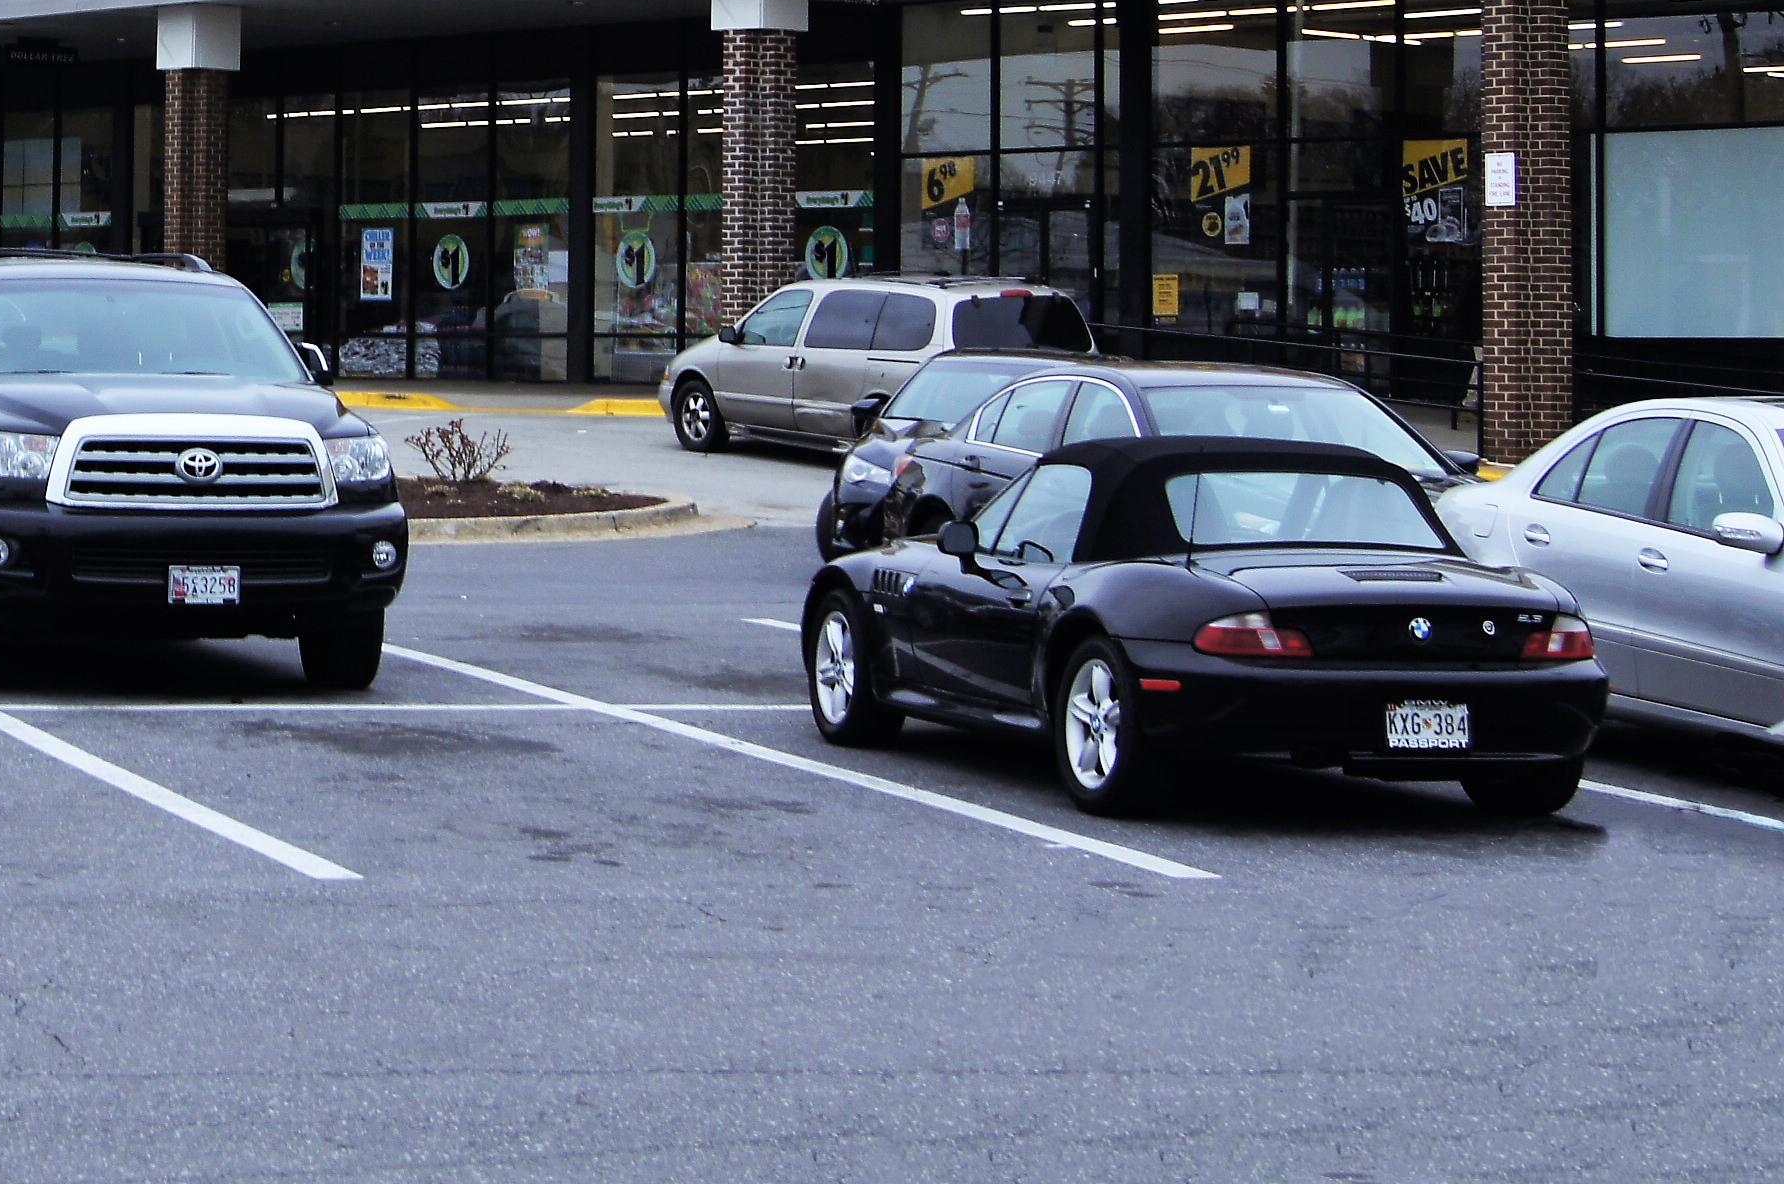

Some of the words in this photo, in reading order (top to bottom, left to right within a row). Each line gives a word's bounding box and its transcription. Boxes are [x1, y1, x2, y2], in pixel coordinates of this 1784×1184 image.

[1401, 146, 1467, 197] SAVE
[1404, 197, 1438, 225] $40
[1388, 711, 1422, 736] KXG
[1433, 712, 1467, 736] 384
[1388, 738, 1469, 750] PASSPORT
